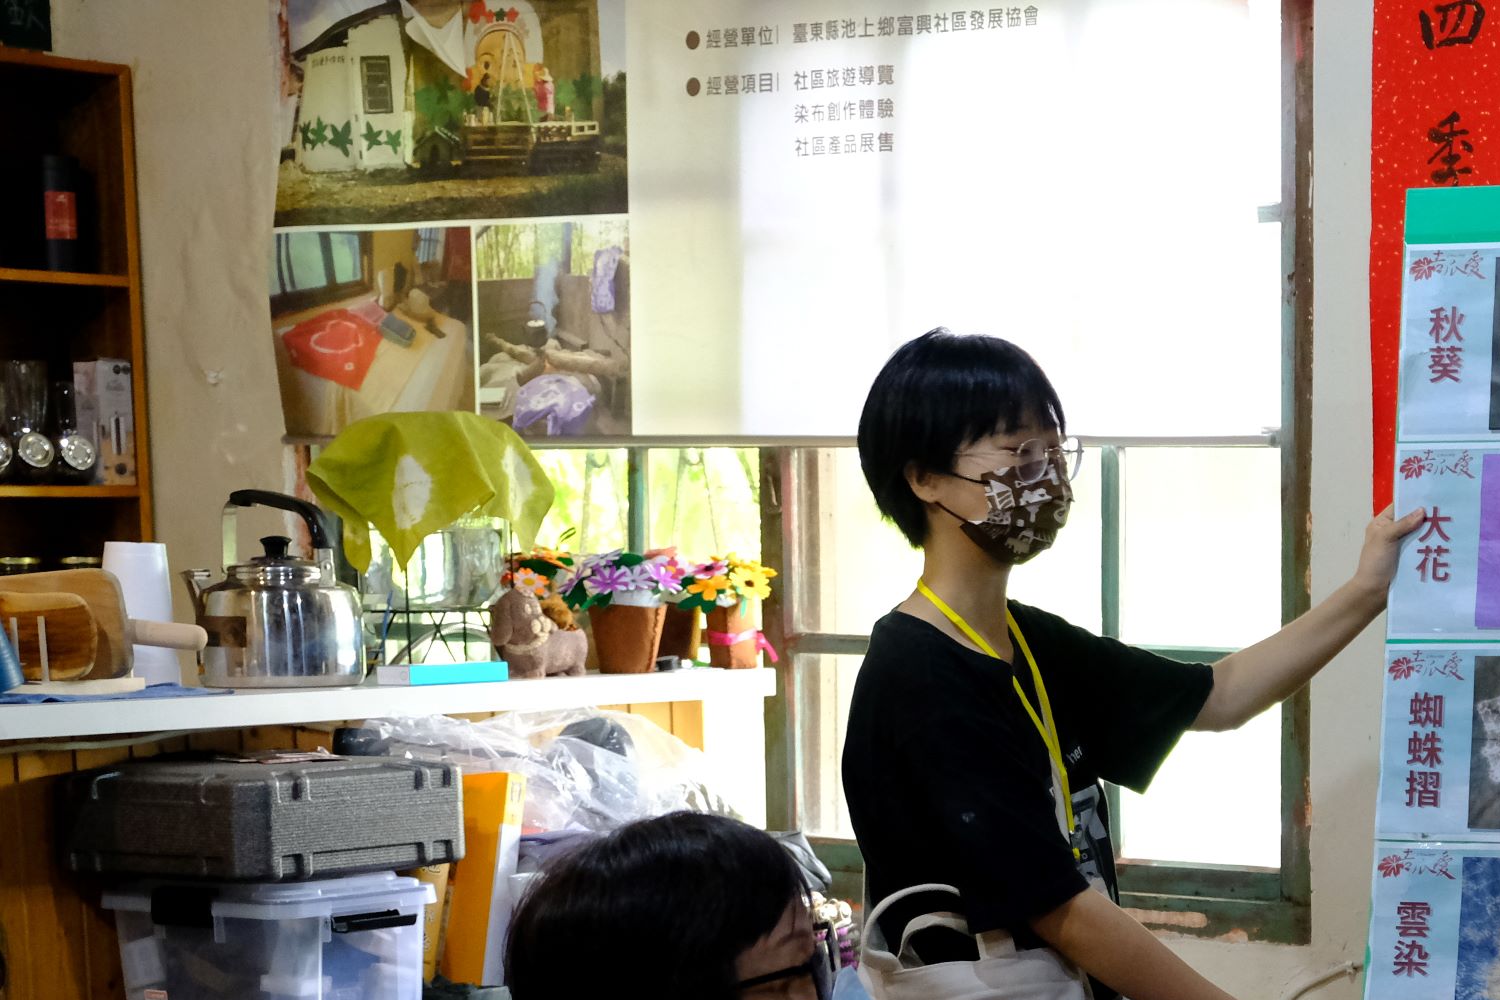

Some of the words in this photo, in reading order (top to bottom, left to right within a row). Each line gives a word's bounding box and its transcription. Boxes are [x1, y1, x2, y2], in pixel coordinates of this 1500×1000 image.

[794, 65, 895, 91] 社區旅遊導覽
[794, 98, 894, 124] 染布創作體驗
[1419, 0, 1485, 187] 四季
[795, 132, 894, 157] 社區產品展售
[1428, 306, 1464, 383] 秋葵
[1416, 506, 1452, 582] 大花
[1405, 692, 1444, 808] 蜘蛛摺
[1392, 902, 1430, 977] 雲染
